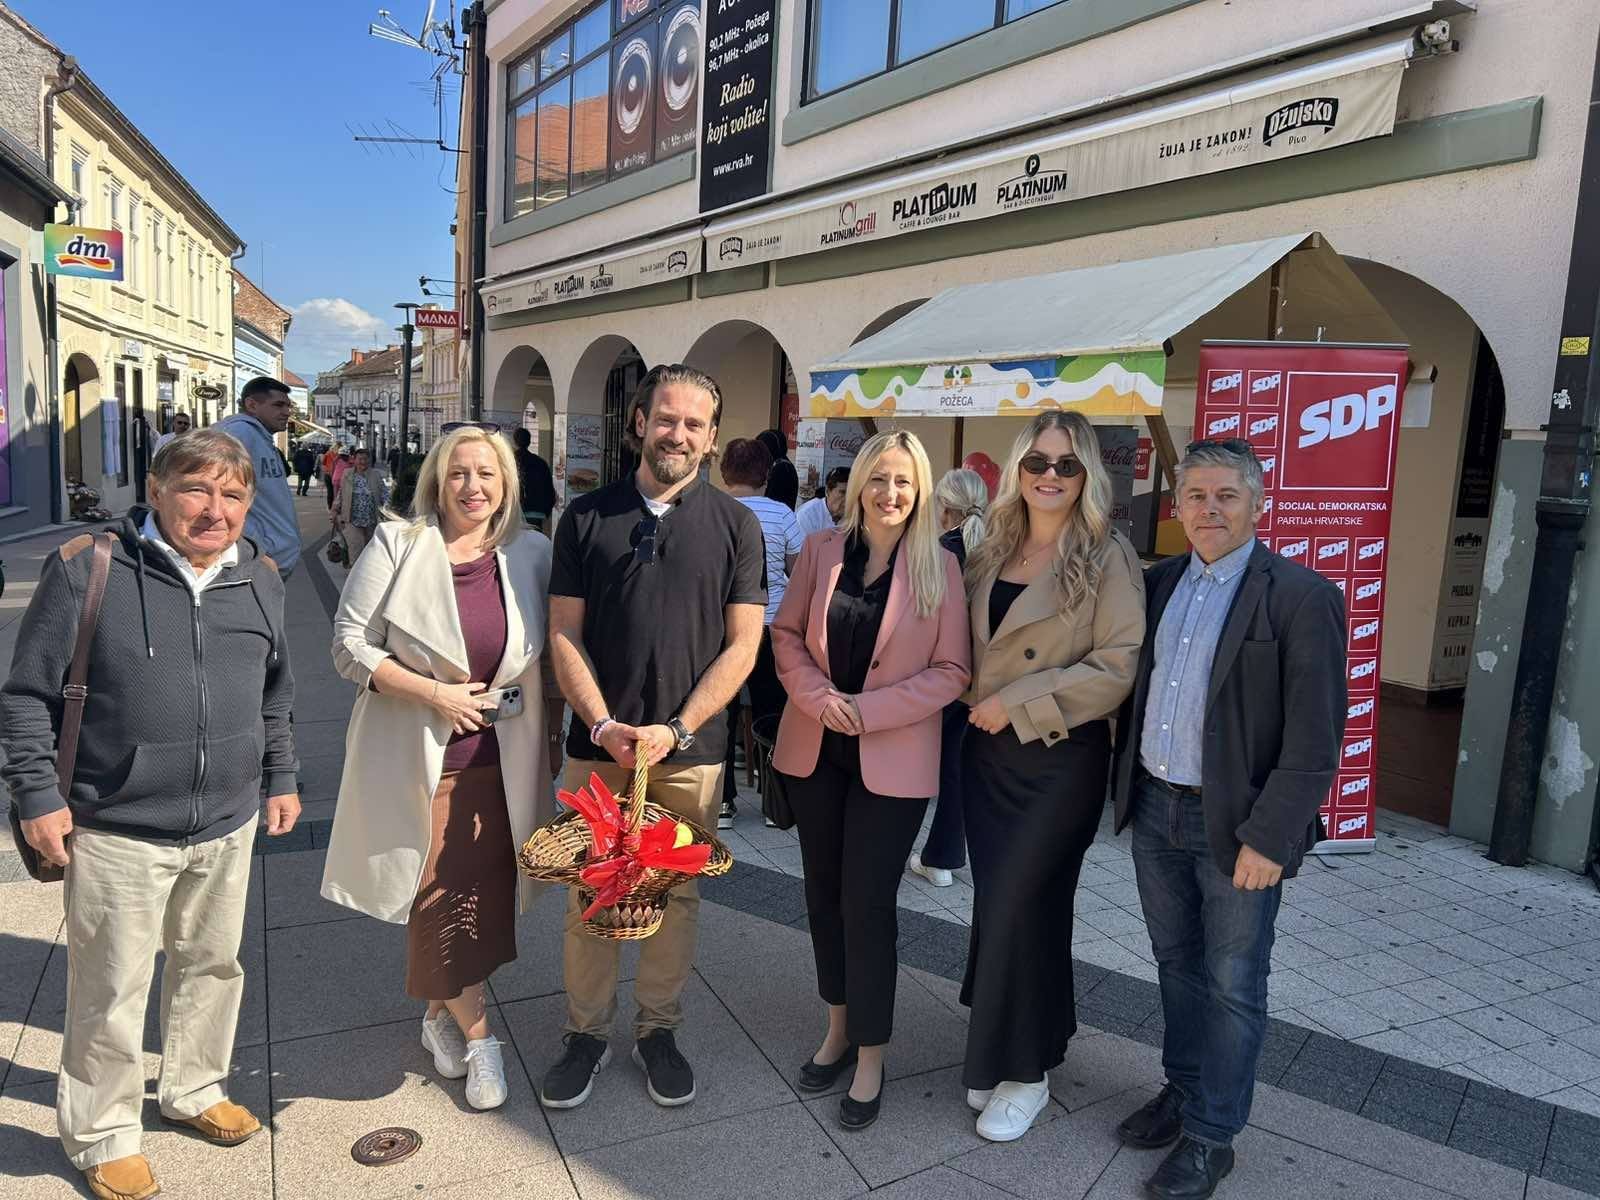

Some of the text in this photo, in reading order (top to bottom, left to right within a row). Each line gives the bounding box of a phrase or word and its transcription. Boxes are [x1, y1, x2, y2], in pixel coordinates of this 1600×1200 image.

[710, 37, 724, 52] 90,2
[724, 26, 740, 44] MHz
[745, 11, 770, 32] Požega
[709, 54, 723, 72] 96,7
[723, 47, 740, 65] MHz
[744, 33, 769, 53] okolica
[720, 73, 755, 106] Radio
[707, 115, 729, 144] koji
[730, 98, 768, 134] volite!
[1268, 99, 1334, 138] Ožujsko
[1159, 126, 1252, 158] ŽUJA JE ZAKON!
[713, 153, 753, 176] www.rva.hr
[996, 172, 1068, 205] PLATINUM
[923, 213, 947, 226] LOUNGE
[948, 210, 962, 221] BAR
[67, 235, 107, 258] dm
[418, 313, 457, 325] MANA
[1211, 373, 1242, 393] SDP
[1252, 374, 1281, 393] SDP
[940, 393, 974, 406] POŽEGA
[1209, 415, 1240, 435] SDP
[1250, 416, 1279, 436] SDP
[1299, 384, 1397, 448] SDP
[1278, 501, 1317, 510] SOCIJAL
[1319, 502, 1387, 511] DEMOKRATSKA
[1277, 516, 1363, 525] PARTIJA HRVATSKE
[1280, 540, 1309, 557] SDP
[1318, 540, 1348, 560] SDP
[1358, 540, 1384, 560] SDP
[1356, 580, 1381, 600] SDP
[1353, 620, 1379, 640] SDP
[1350, 660, 1376, 680] SDP
[1347, 699, 1374, 719] SDP
[1344, 738, 1371, 758] SDP
[1341, 776, 1369, 796] SDP
[1338, 814, 1367, 834] SDP
